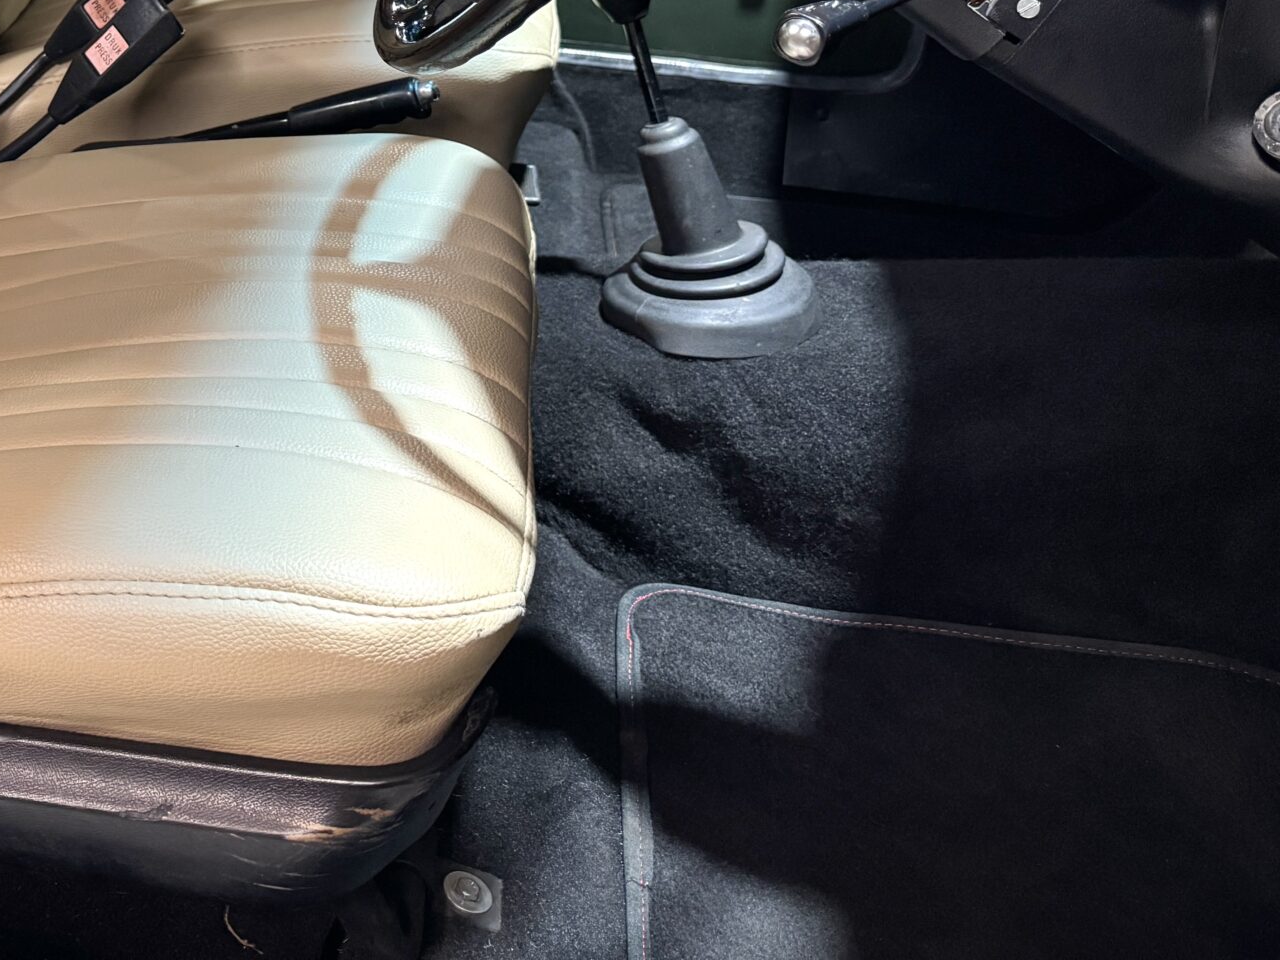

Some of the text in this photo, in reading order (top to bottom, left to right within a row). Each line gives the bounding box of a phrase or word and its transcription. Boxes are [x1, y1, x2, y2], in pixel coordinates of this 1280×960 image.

[91, 0, 110, 23] PRESS
[94, 42, 113, 66] PRESS
[104, 32, 122, 55] DRUK
